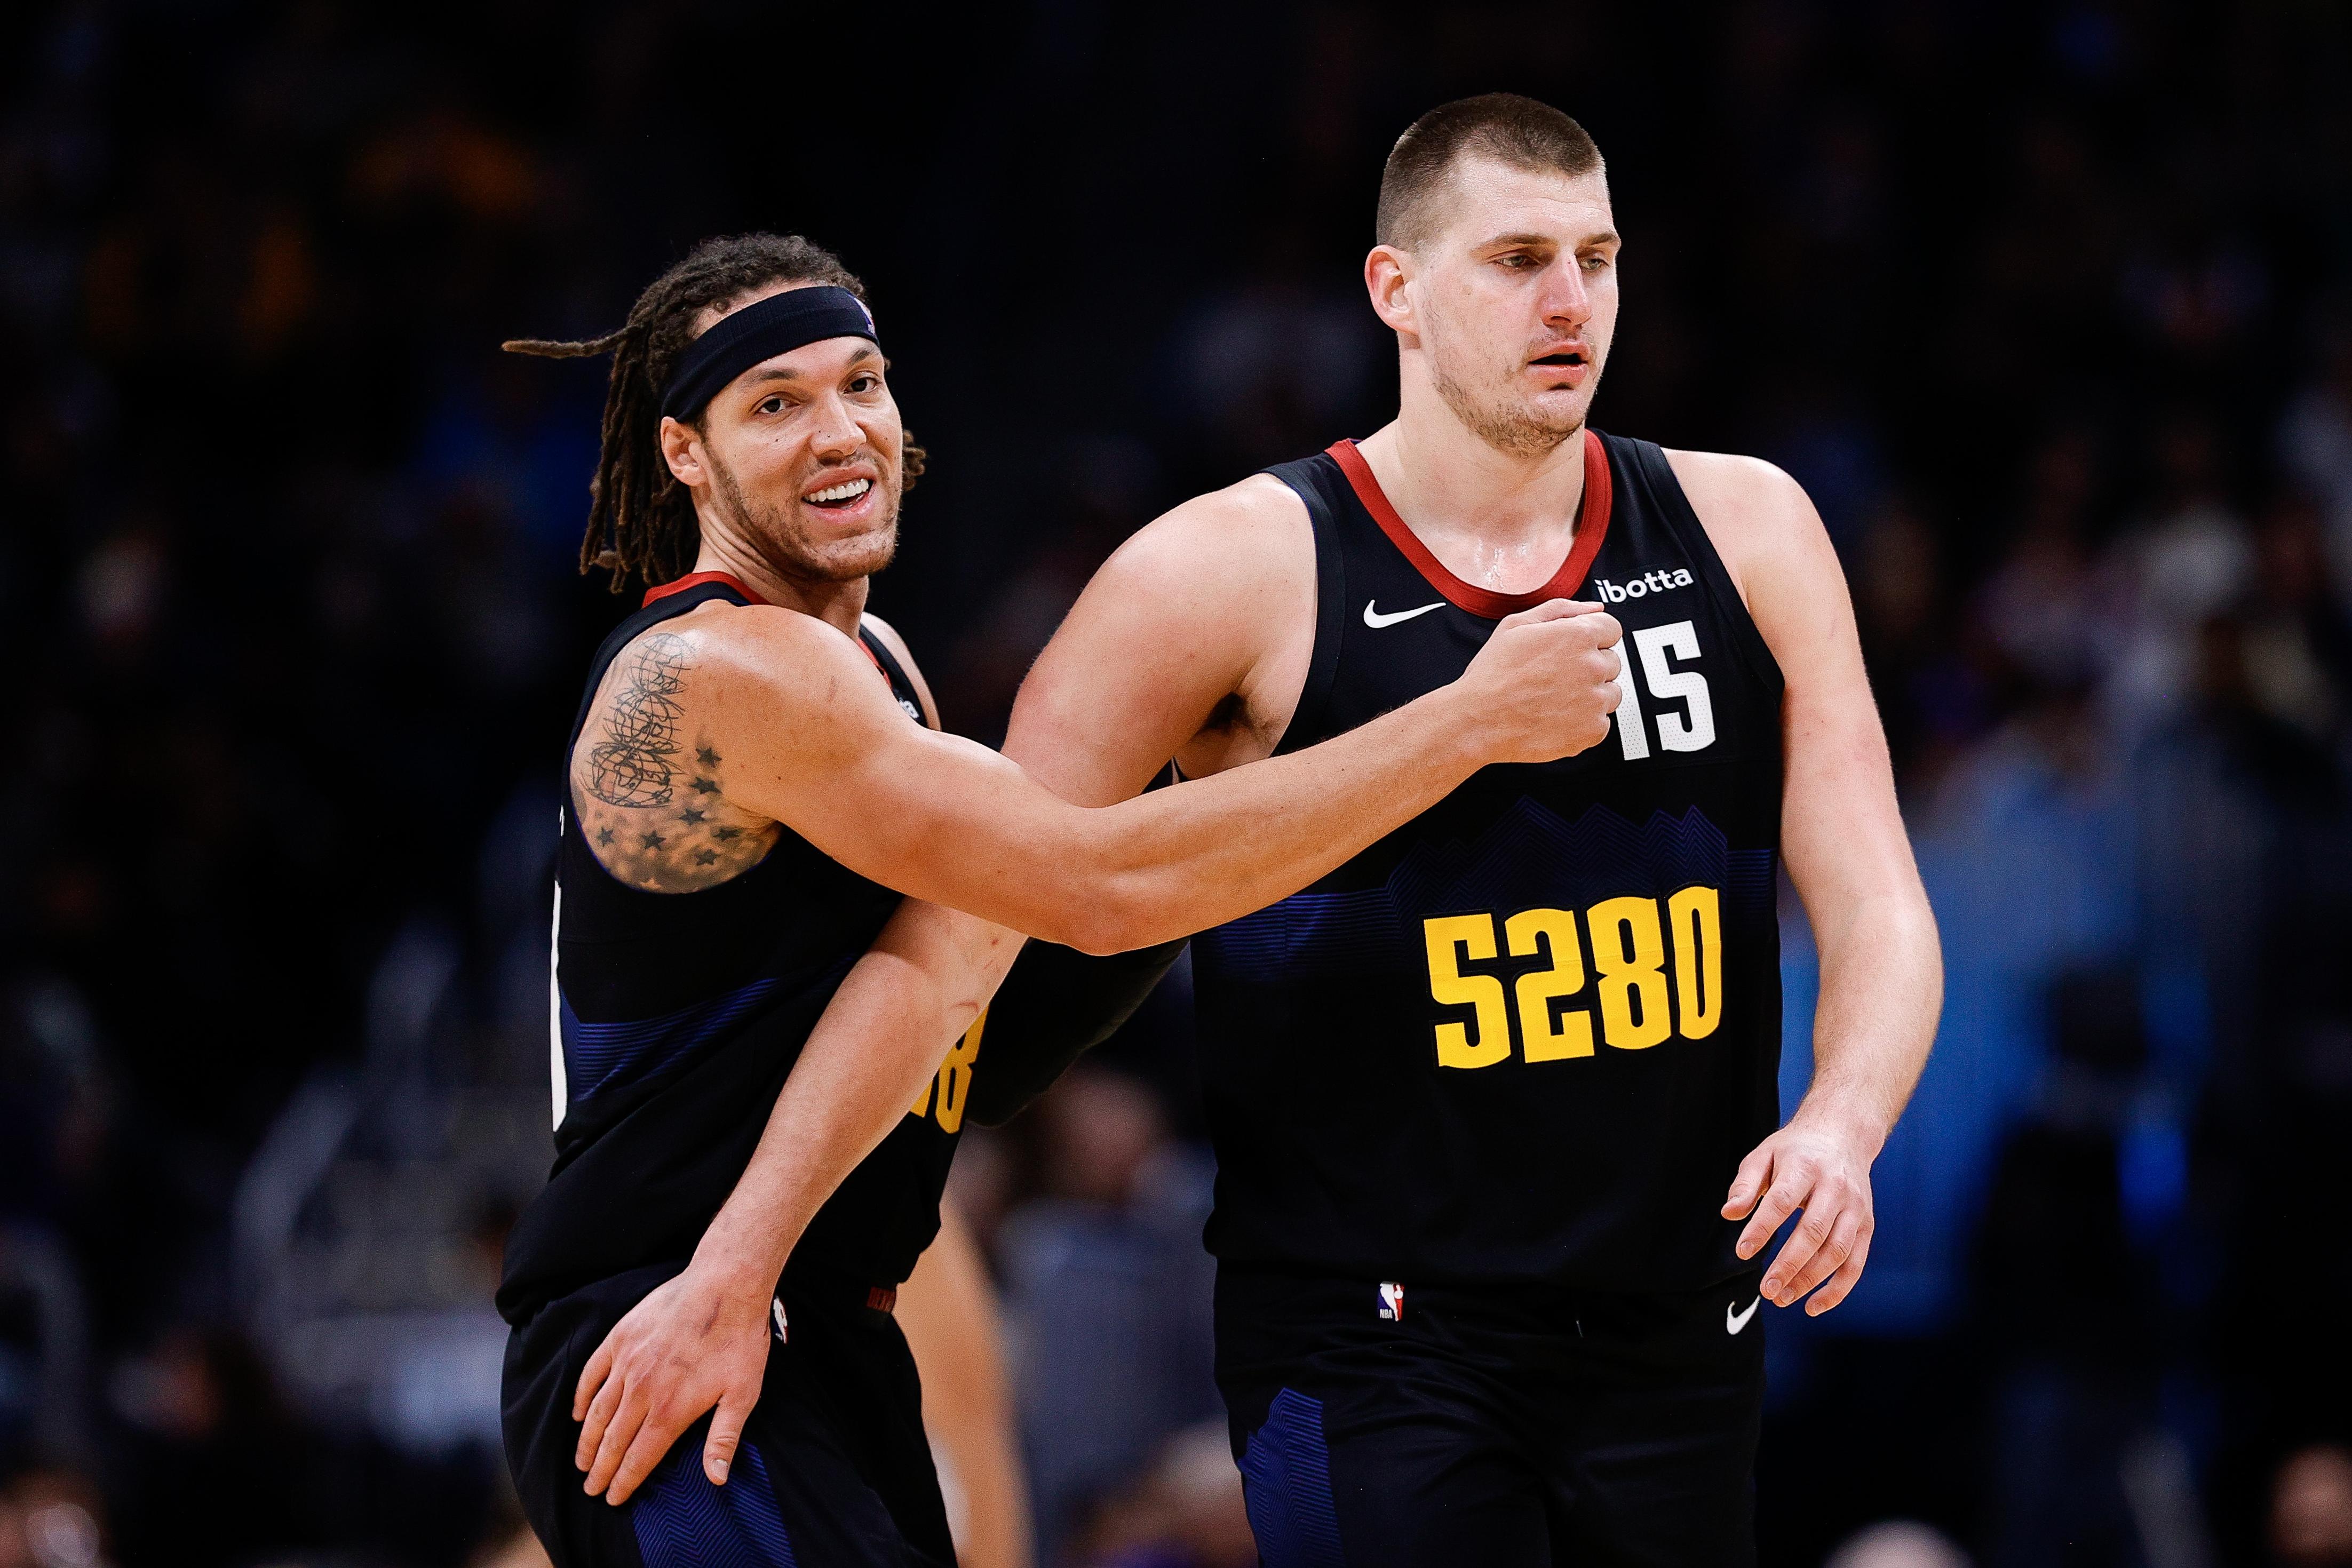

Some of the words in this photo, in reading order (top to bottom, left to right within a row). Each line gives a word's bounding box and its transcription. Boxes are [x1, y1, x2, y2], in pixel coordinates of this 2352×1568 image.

[1594, 568, 1694, 603] ibotta
[1423, 886, 1722, 1069] 5280
[1380, 1309, 1393, 1319] NBA
